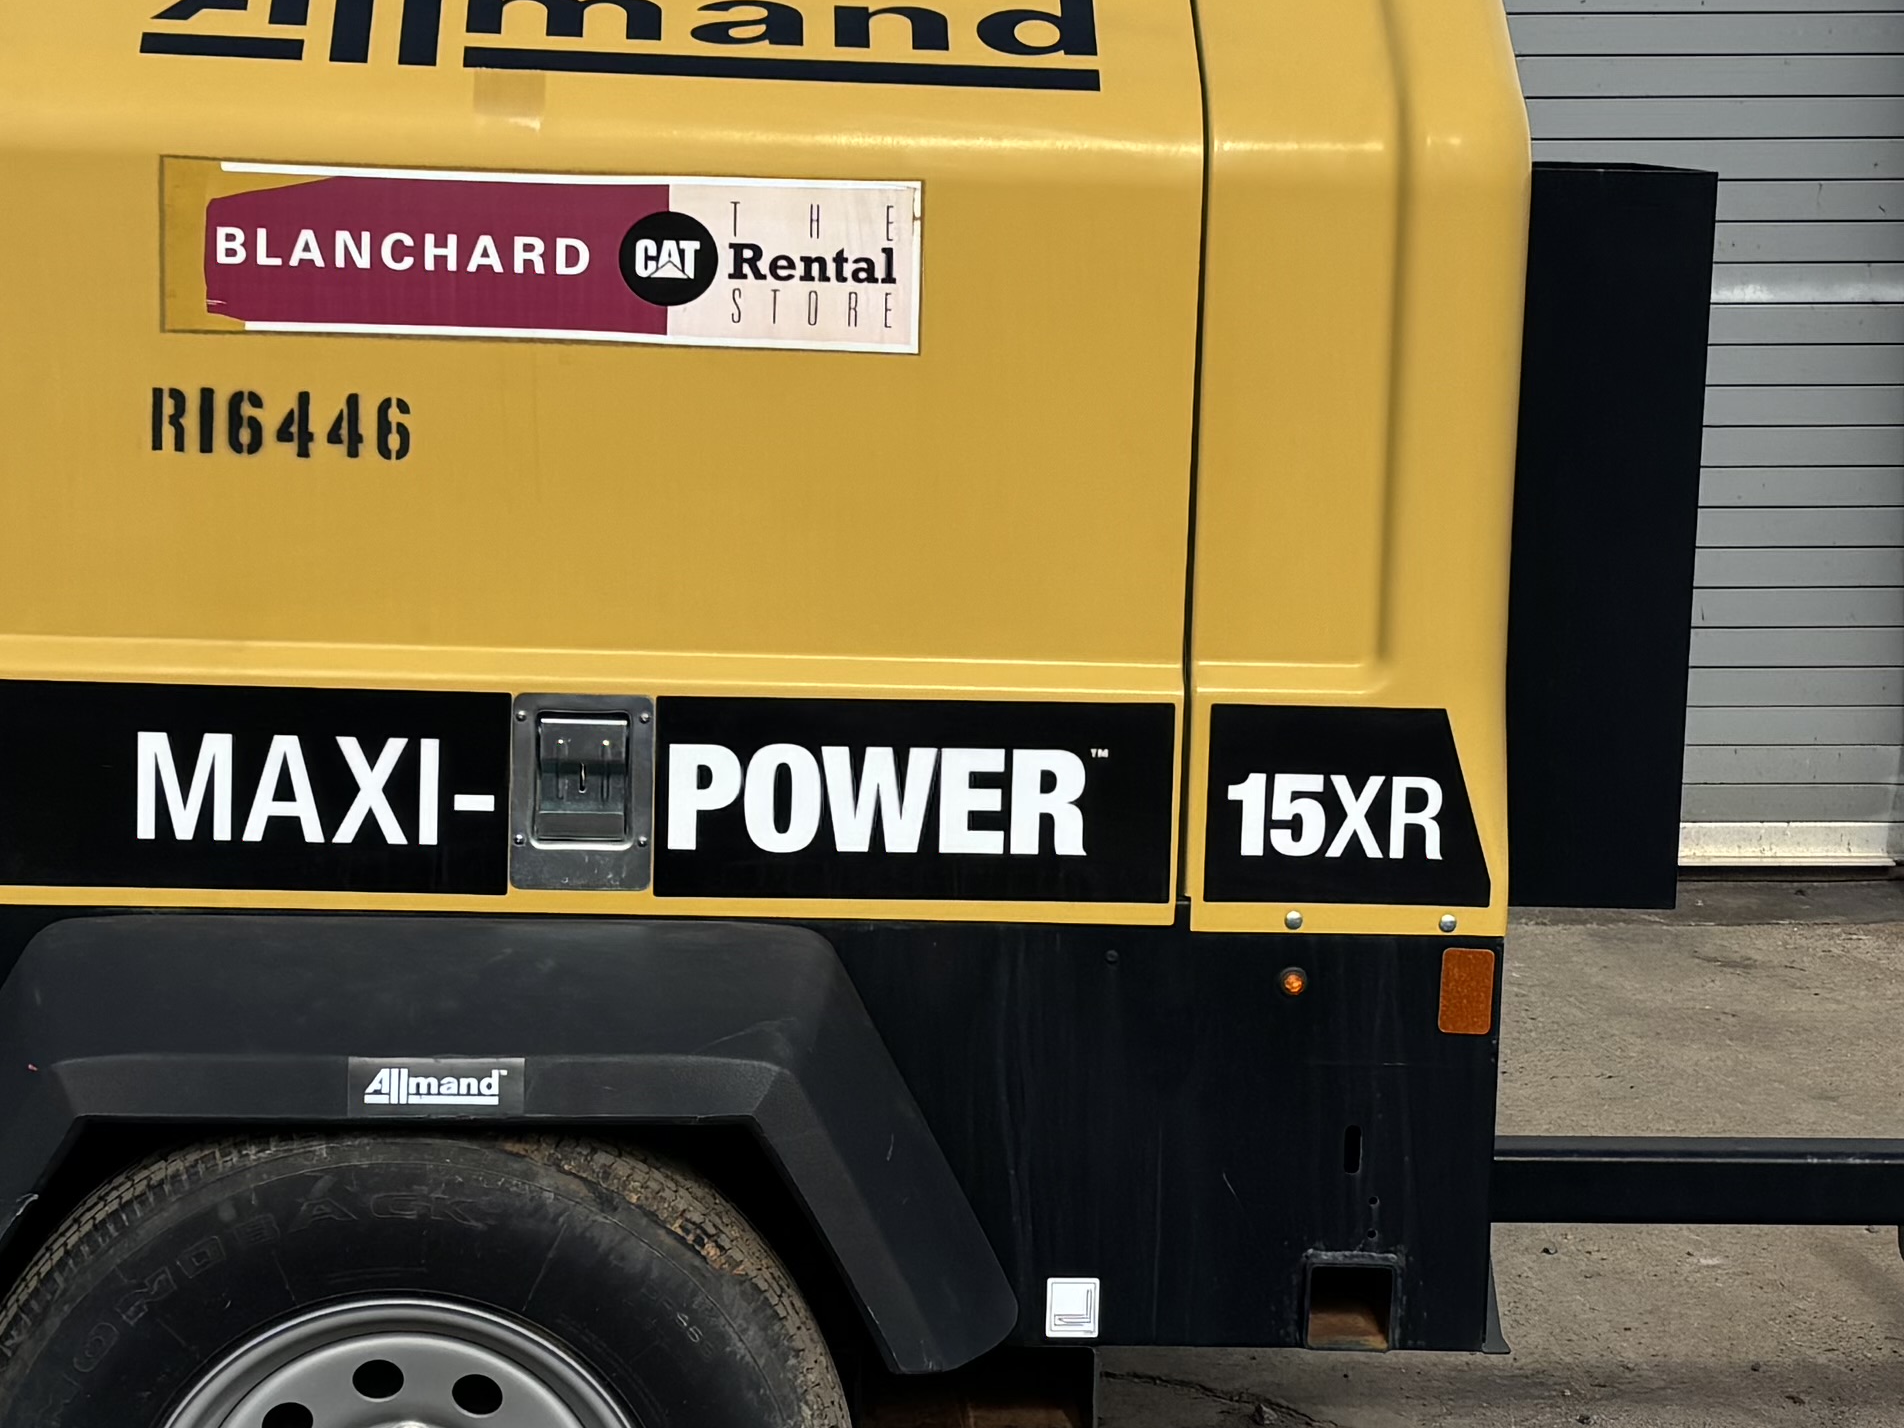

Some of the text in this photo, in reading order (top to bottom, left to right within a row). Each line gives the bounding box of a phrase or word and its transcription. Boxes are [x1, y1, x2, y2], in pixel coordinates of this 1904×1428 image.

[729, 201, 895, 243] THE
[215, 226, 591, 276] BLANCHARD
[634, 238, 700, 280] CAT
[728, 241, 897, 285] Rental
[731, 288, 894, 329] STORE
[137, 731, 495, 845] MAXI-
[1226, 772, 1444, 861] 15XR
